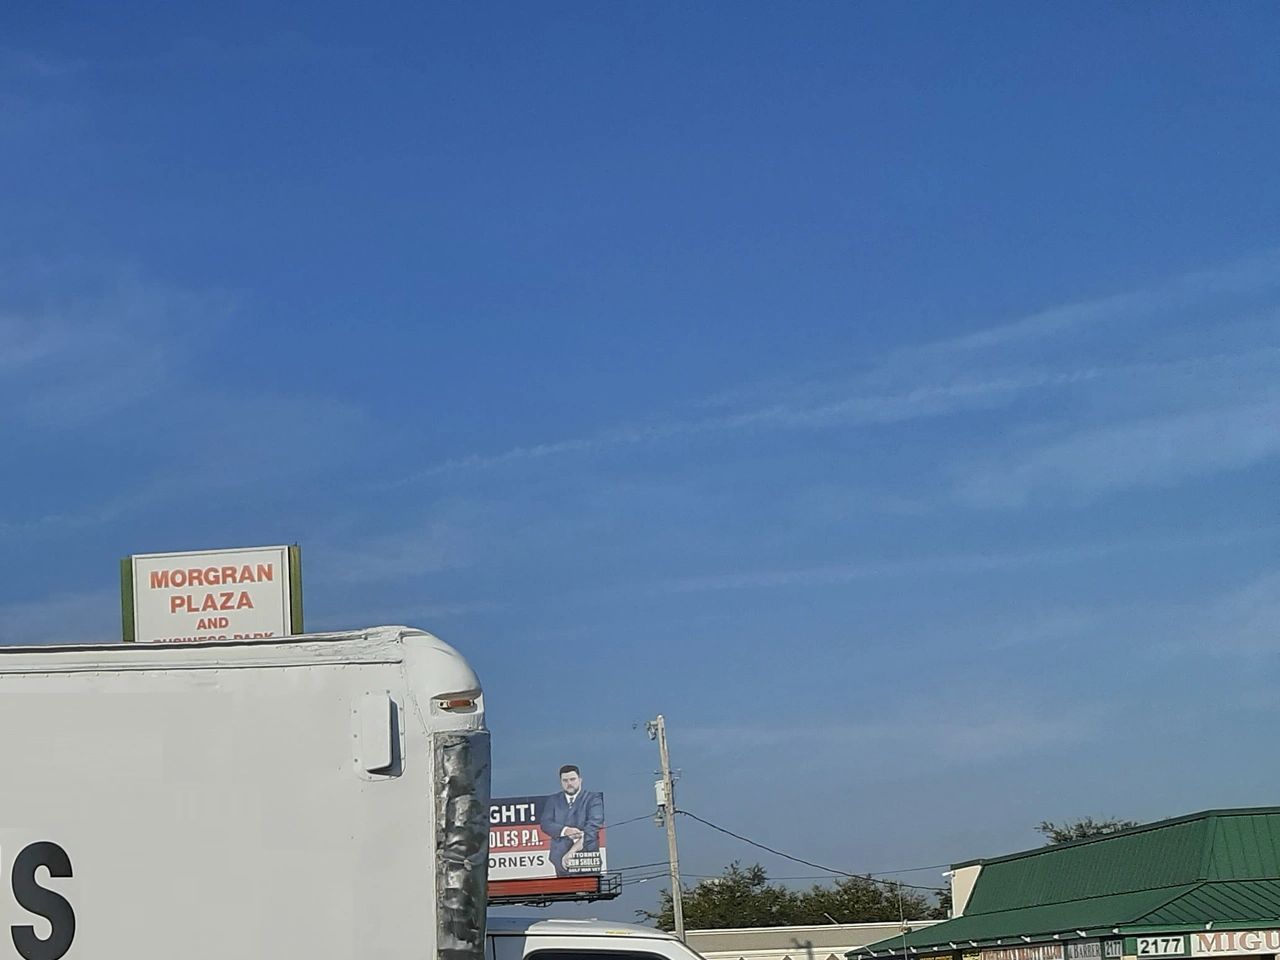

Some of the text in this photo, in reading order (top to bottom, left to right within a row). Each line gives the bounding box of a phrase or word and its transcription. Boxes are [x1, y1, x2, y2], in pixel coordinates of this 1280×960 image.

[150, 564, 273, 589] MORGRAN
[170, 591, 254, 614] PLAZA
[196, 617, 229, 630] AND
[489, 803, 536, 824] GHT!
[488, 855, 545, 868] ORNEYS
[1105, 942, 1121, 956] 2177
[1140, 939, 1181, 953] 2177
[1196, 930, 1280, 953] MIGU
[1073, 943, 1100, 959] BARBER
